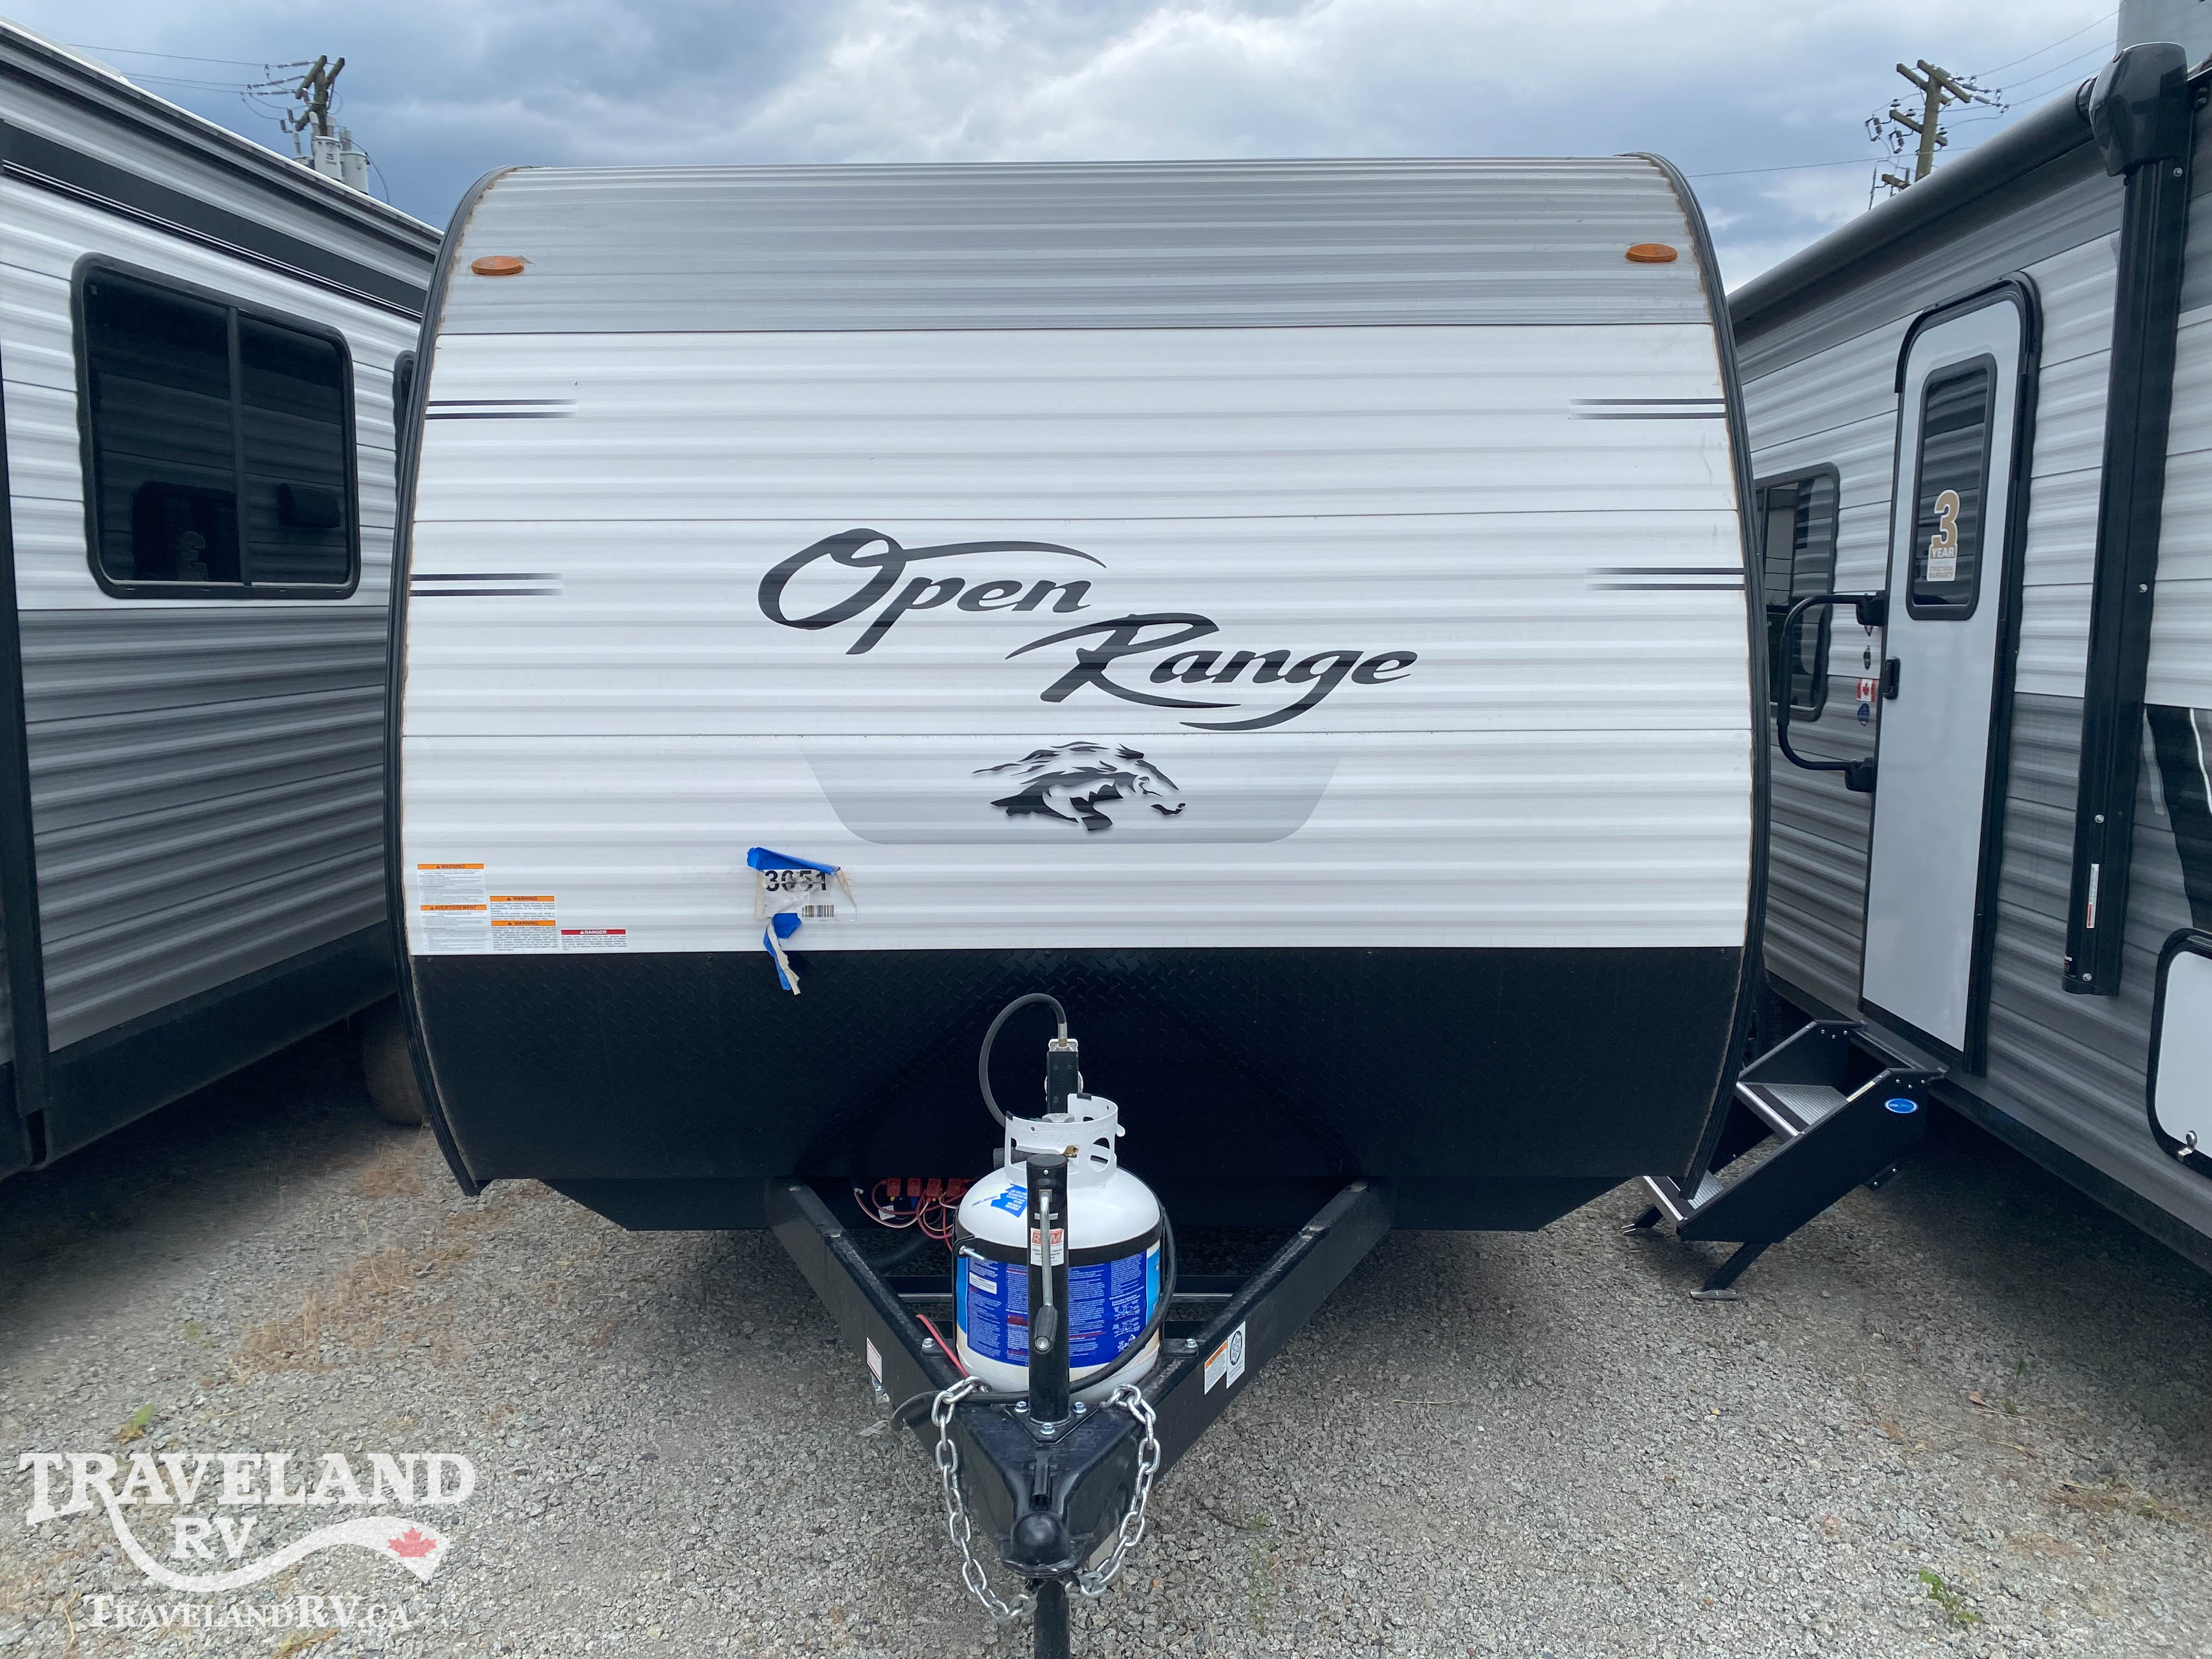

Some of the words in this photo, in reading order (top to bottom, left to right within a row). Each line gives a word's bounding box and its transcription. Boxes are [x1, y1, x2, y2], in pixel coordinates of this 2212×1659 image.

[1931, 489, 1960, 548] 3
[1931, 546, 1955, 558] YEAR
[758, 527, 1107, 656] Open
[1005, 613, 1418, 731] Range
[1032, 1233, 1063, 1244] RM
